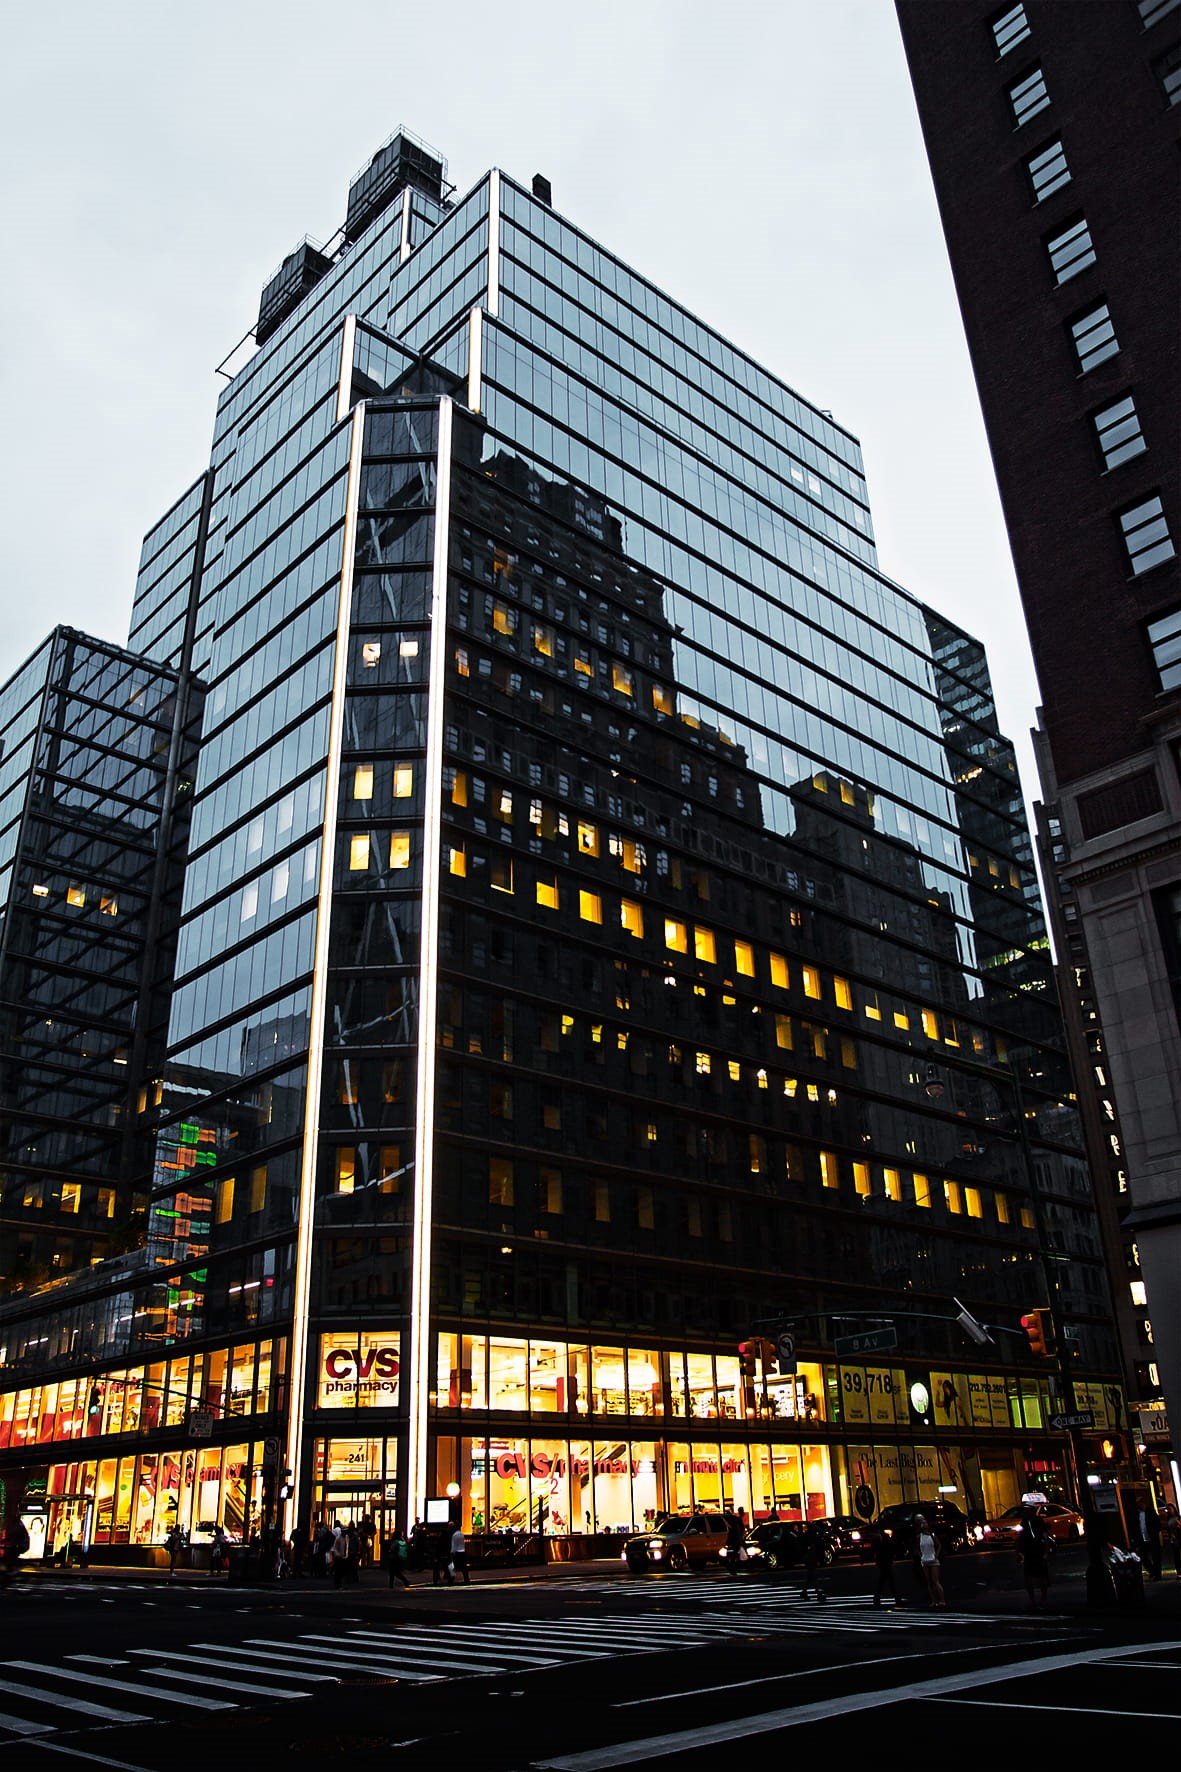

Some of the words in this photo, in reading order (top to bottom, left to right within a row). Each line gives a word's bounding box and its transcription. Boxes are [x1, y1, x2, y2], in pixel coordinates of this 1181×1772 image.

[326, 1348, 400, 1379] CVS
[326, 1381, 398, 1395] pharmacy
[843, 1372, 892, 1397] 39,718
[348, 1454, 365, 1464] 241
[916, 1454, 933, 1468] Box
[761, 1471, 794, 1485] grcery
[550, 1478, 559, 1495] 2
